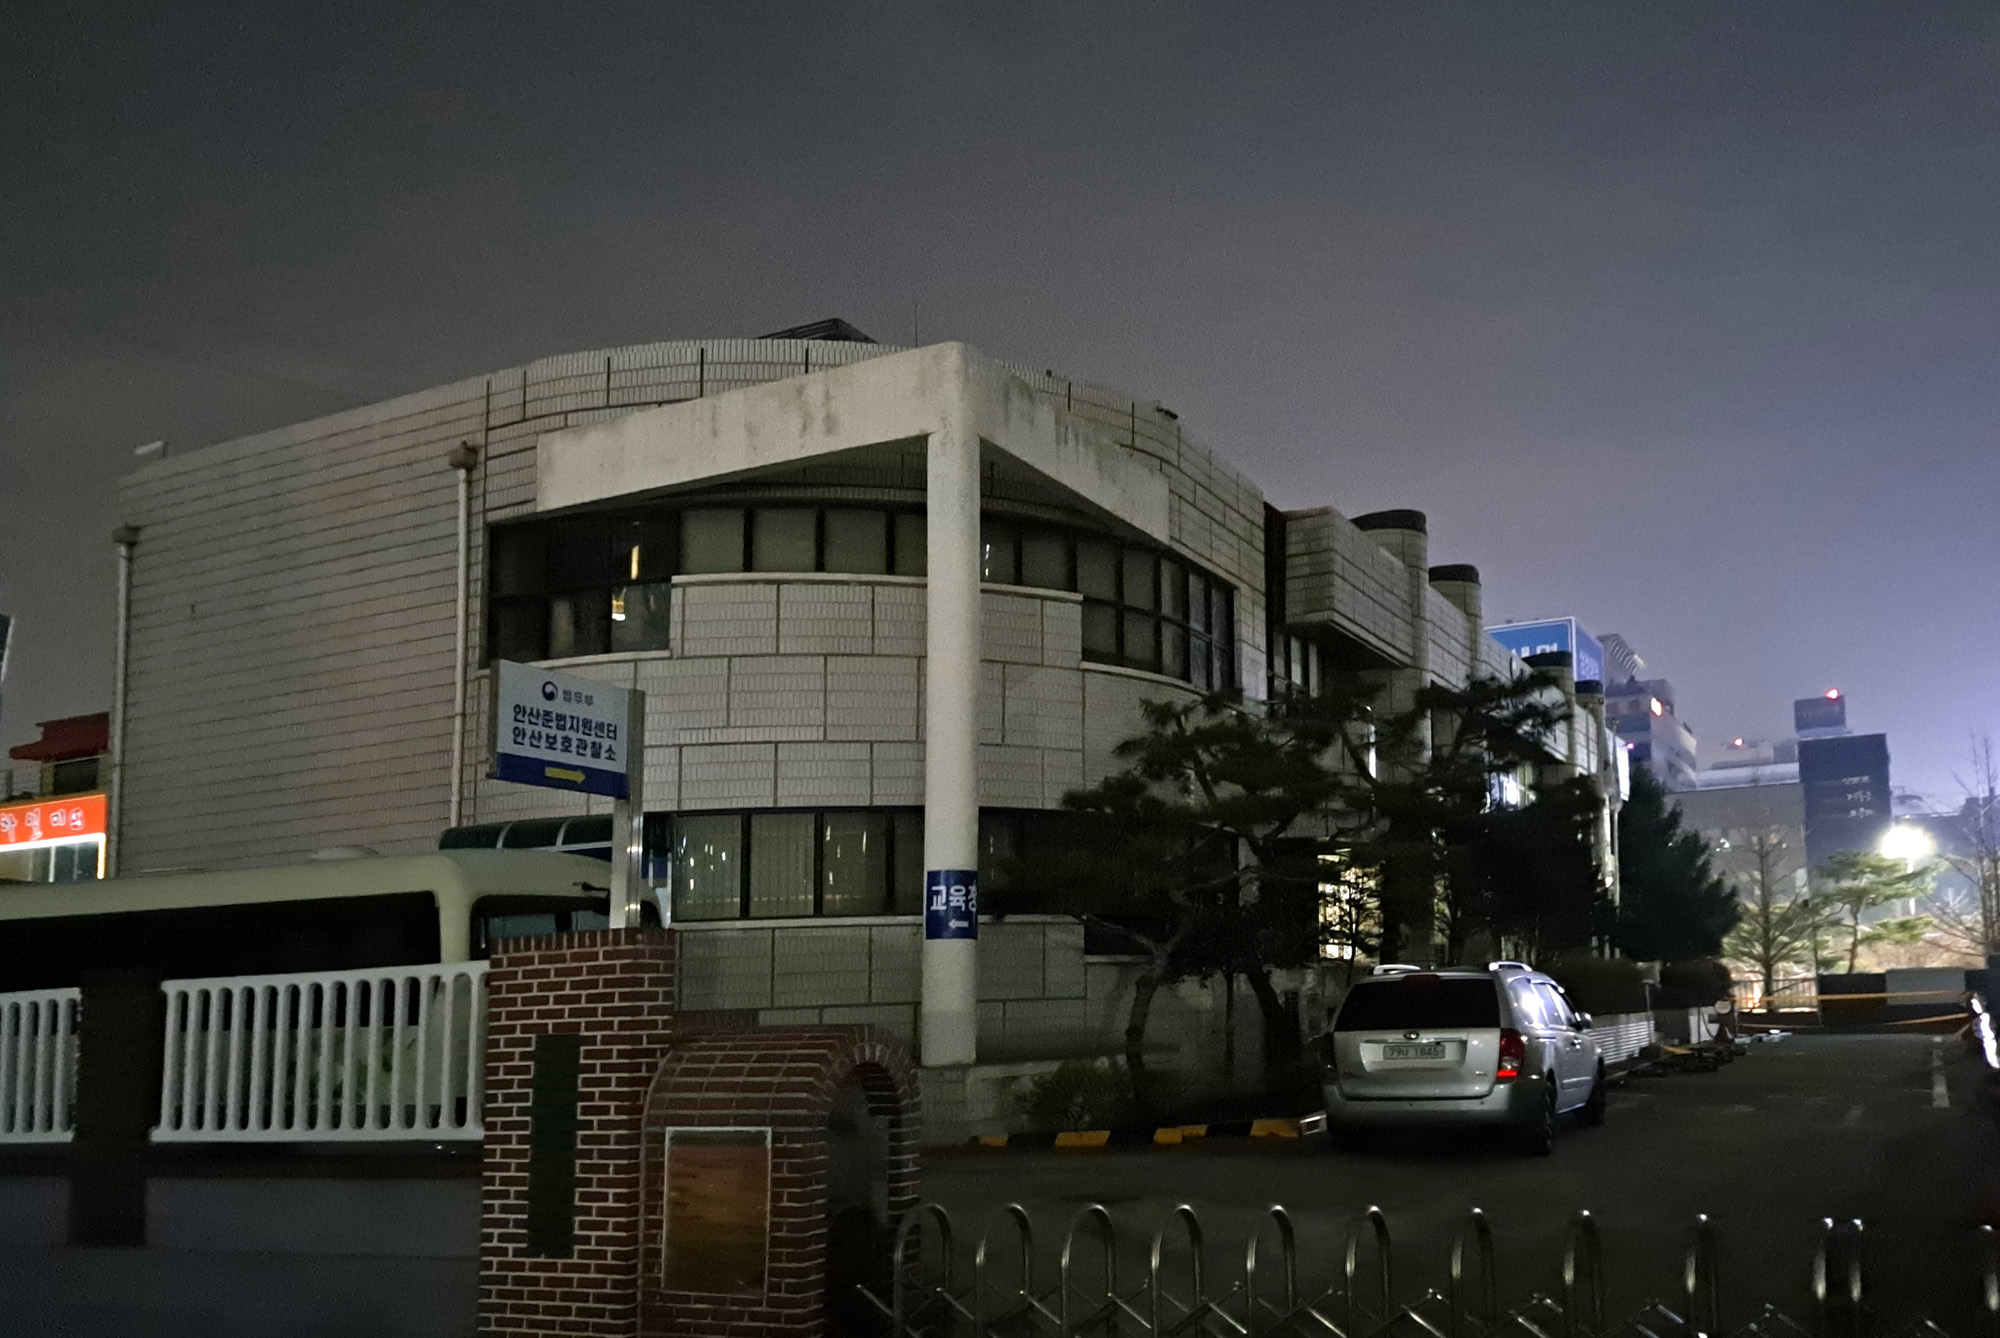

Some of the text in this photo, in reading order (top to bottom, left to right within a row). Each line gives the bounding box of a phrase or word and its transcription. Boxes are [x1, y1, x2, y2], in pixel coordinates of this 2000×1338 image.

[562, 689, 594, 707] 법무부
[513, 703, 618, 741] 안산준법지원센터
[512, 726, 617, 761] 안산보호관찰소
